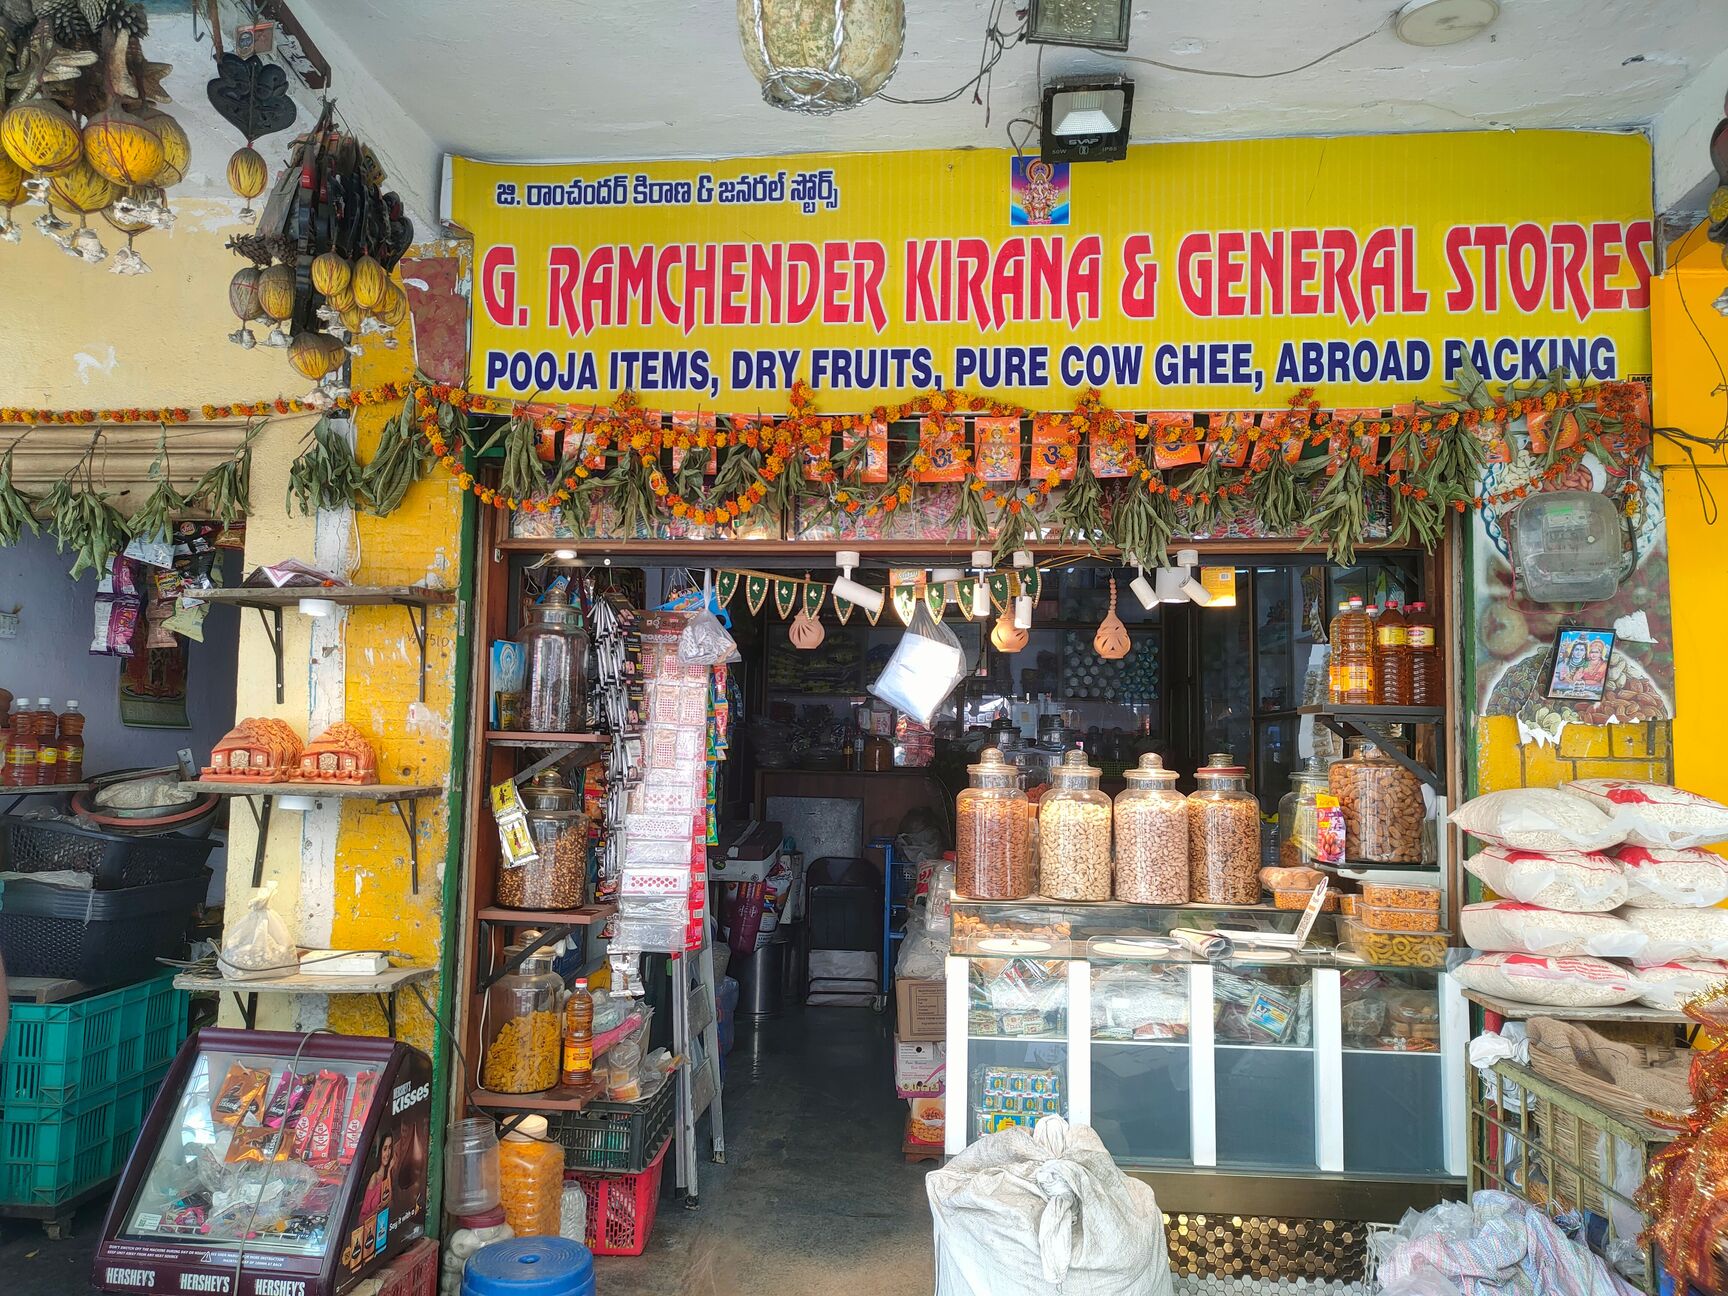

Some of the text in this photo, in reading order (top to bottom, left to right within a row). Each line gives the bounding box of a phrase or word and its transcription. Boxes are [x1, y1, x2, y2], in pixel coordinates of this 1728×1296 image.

[496, 170, 838, 214] జి. రాంచందర్ కిరాణ & జనరల్ స్టోర్స్
[482, 221, 1652, 338] G. RAMCHENDER KIRANA & GENERAL STORES
[487, 336, 1616, 398] POOJA ITEMS, DRY FRUITS, PURE COW GHEE, ABROAD PACKING
[106, 1266, 156, 1288] HERSHEY'S
[180, 1272, 231, 1293] HERSHEY'S
[254, 1278, 306, 1296] HERSHEY'S
